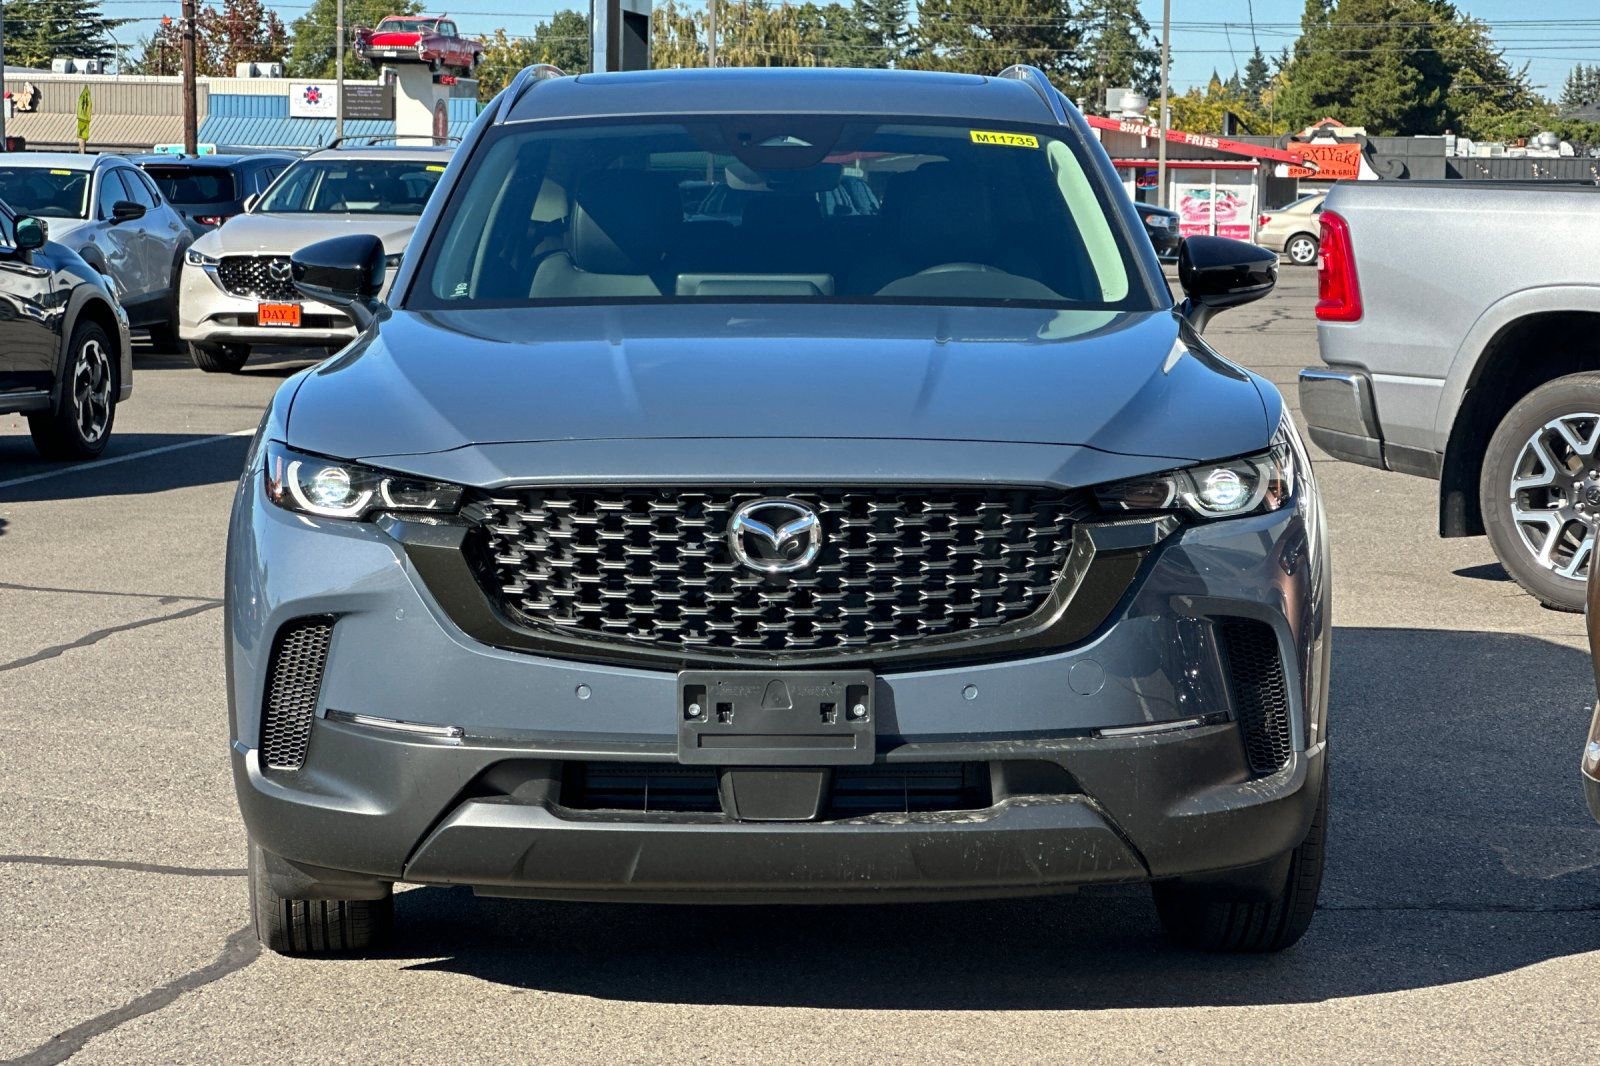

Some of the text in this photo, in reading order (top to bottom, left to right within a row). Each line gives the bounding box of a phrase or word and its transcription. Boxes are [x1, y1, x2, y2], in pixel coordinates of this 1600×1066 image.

[976, 133, 1034, 147] M11735
[1185, 133, 1219, 148] FRIES
[1298, 147, 1359, 167] eXiYaki
[262, 309, 296, 320] DAY 1
